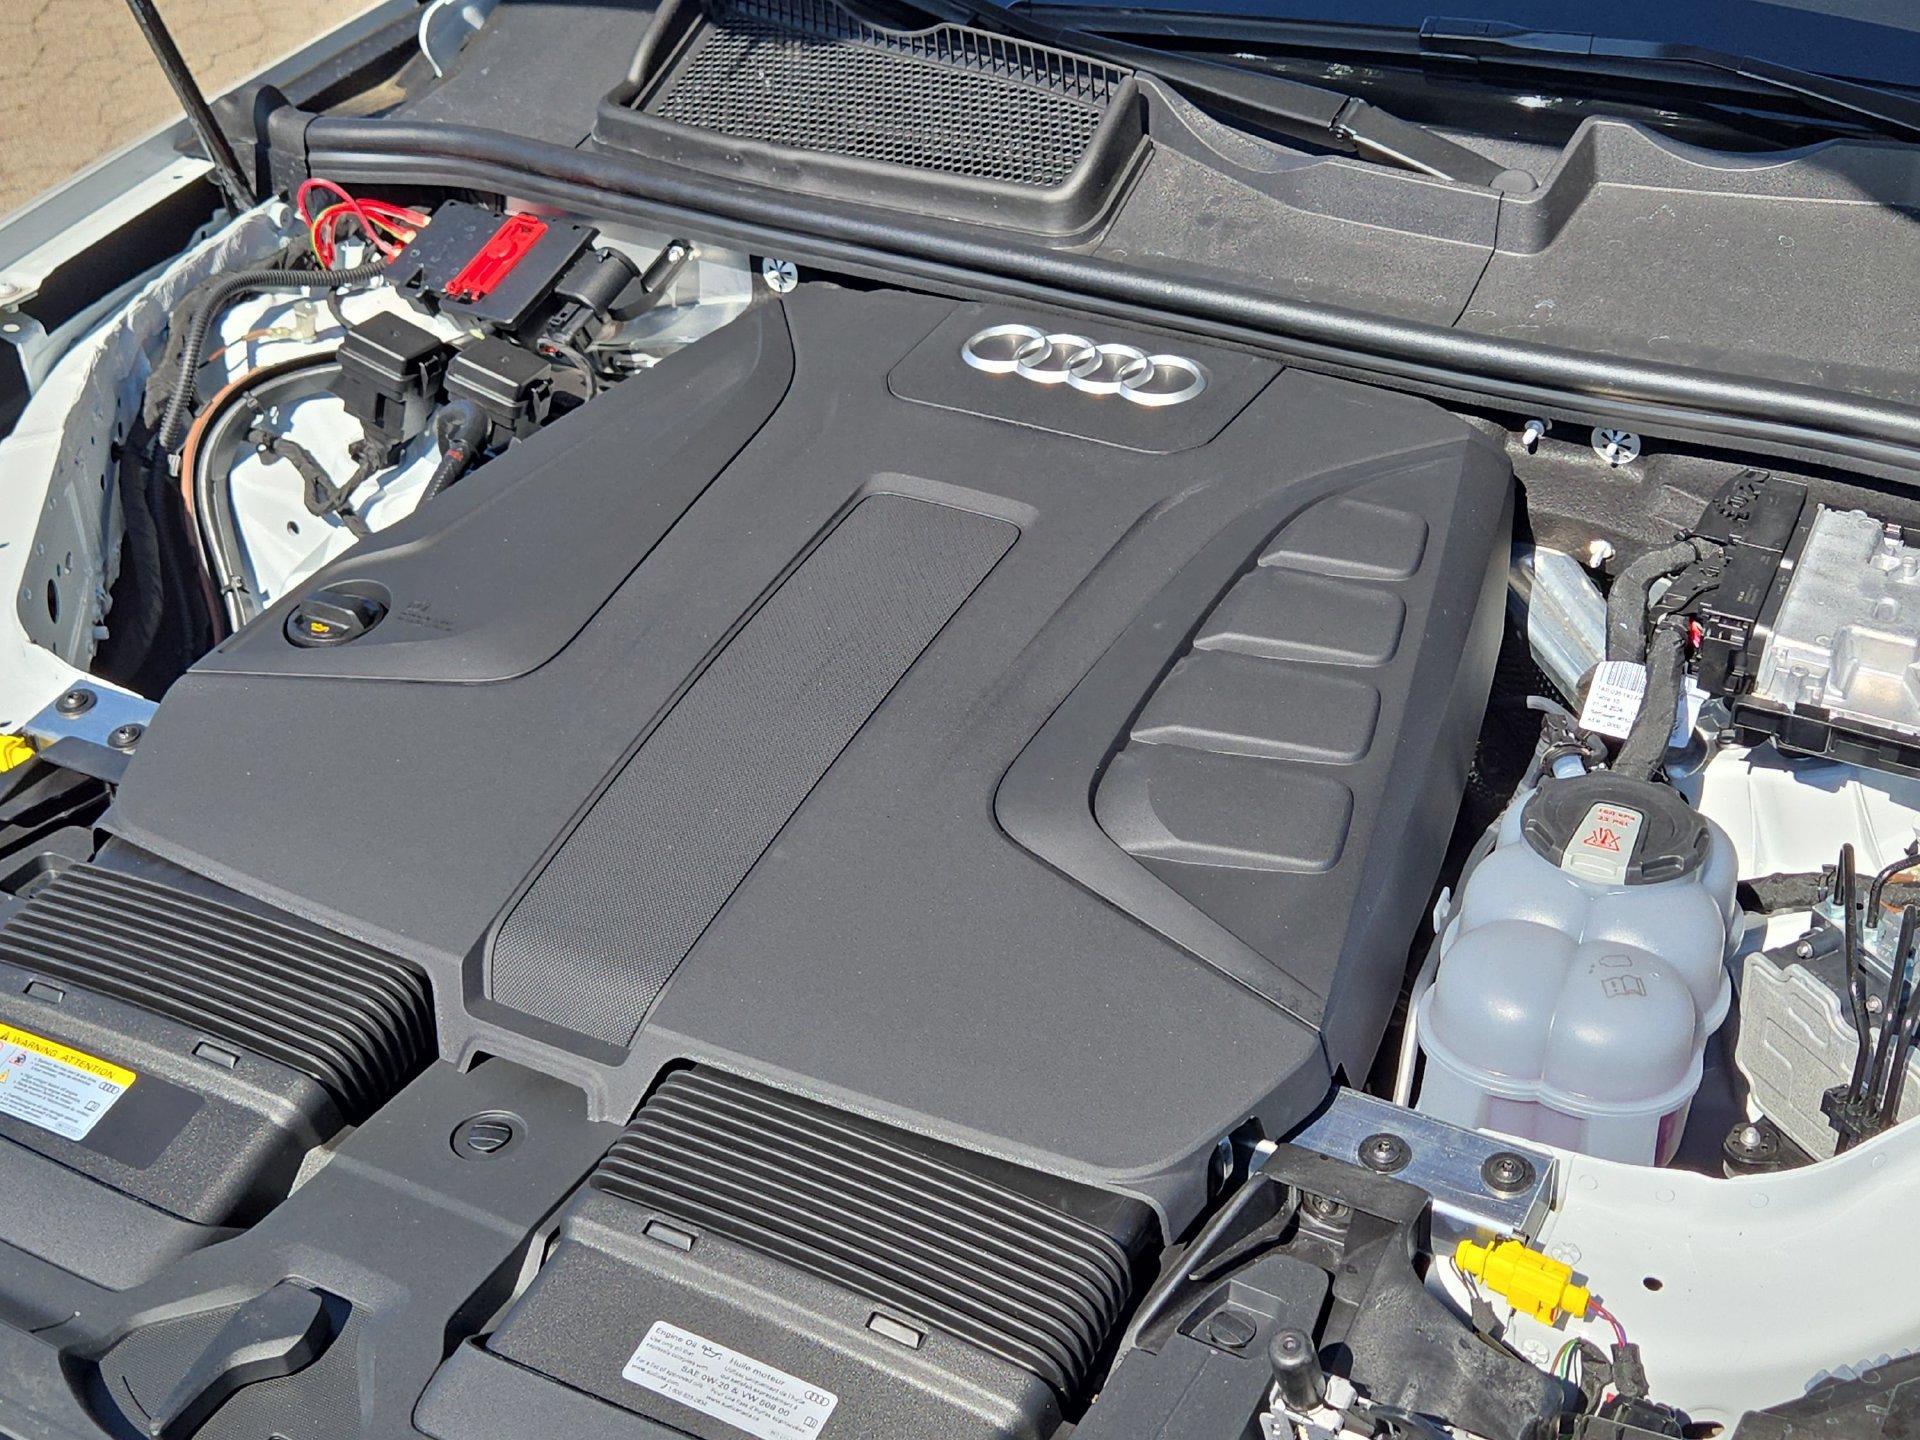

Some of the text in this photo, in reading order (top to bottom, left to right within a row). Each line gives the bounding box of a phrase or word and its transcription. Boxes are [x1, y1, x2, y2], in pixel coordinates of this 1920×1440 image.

[12, 1036, 58, 1057] WARNING
[60, 1054, 117, 1079] ATTENTION
[655, 1327, 697, 1348] Engine Oil
[729, 1357, 785, 1385] Huile moteur
[680, 1365, 699, 1377] SAE
[701, 1374, 729, 1390] 0W-20
[742, 1390, 759, 1402] VW
[777, 1407, 790, 1416] 00
